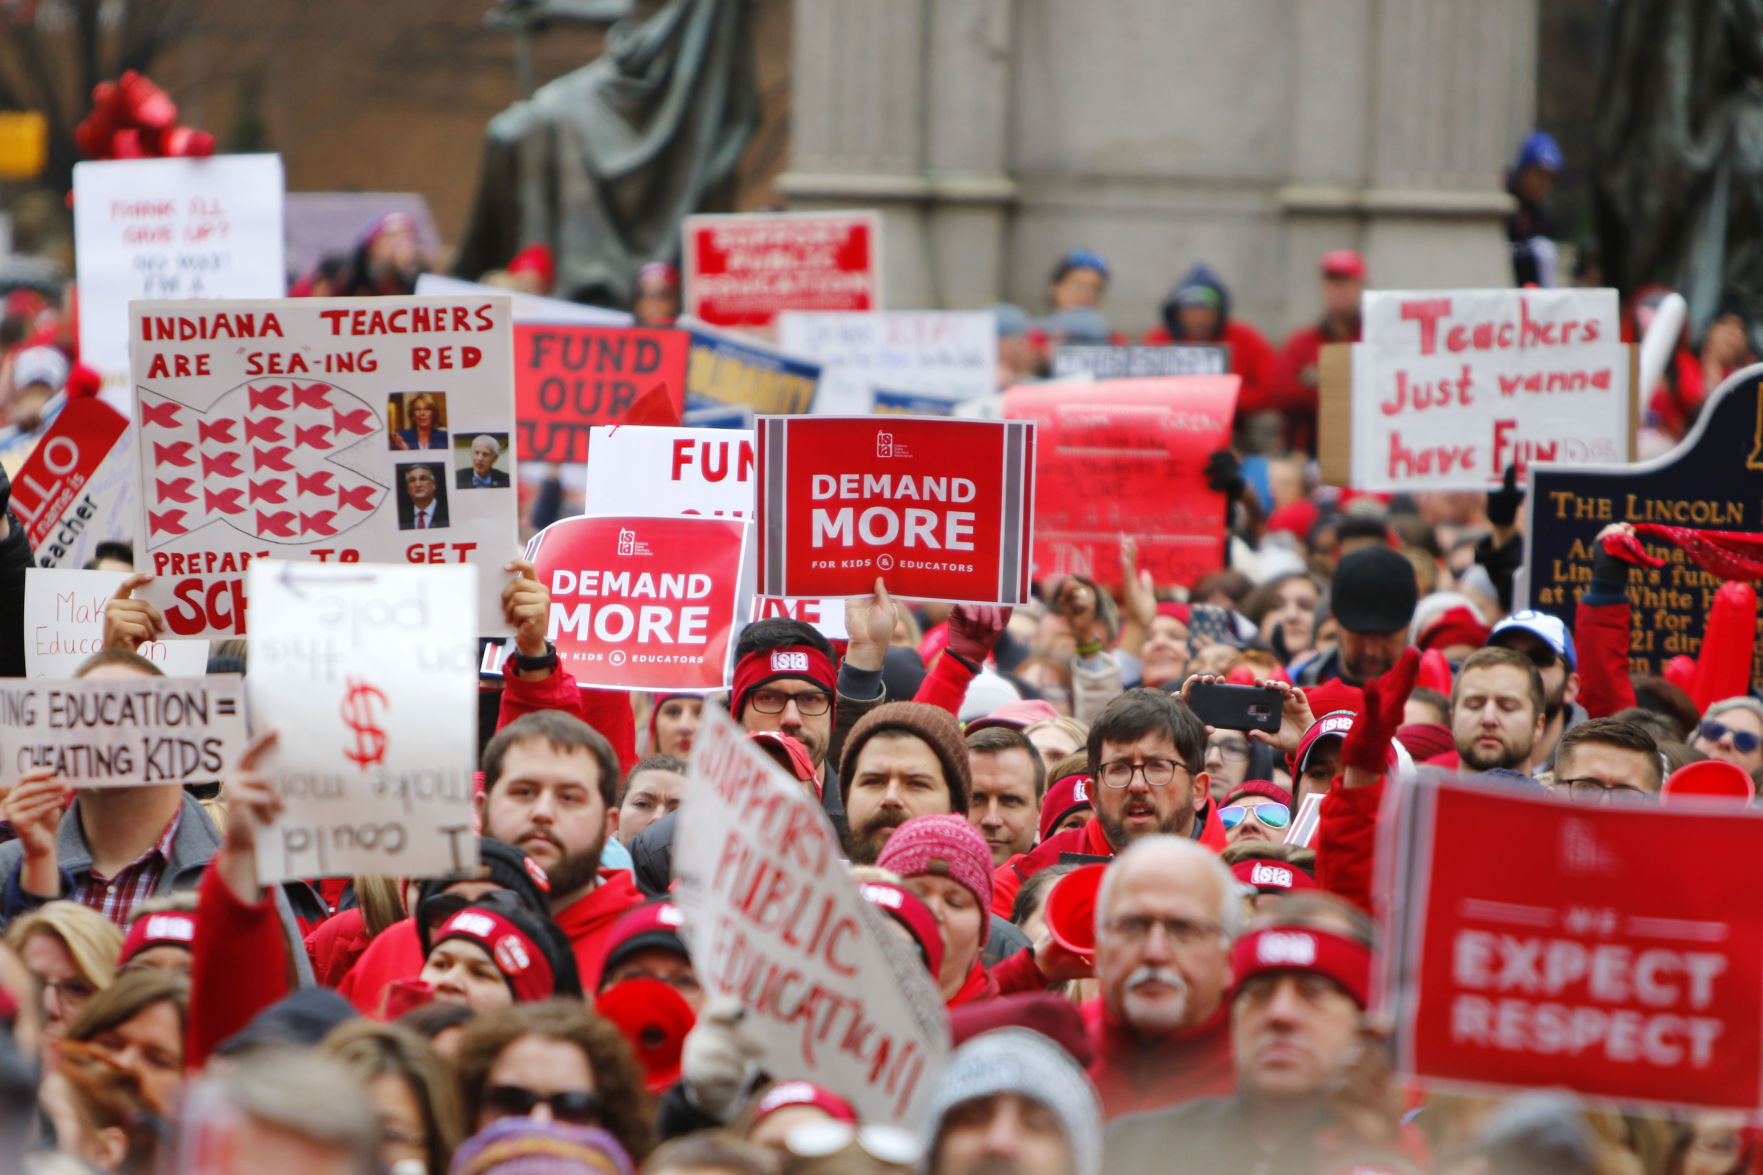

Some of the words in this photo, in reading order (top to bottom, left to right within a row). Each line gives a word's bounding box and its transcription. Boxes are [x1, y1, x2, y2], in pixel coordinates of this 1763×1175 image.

[141, 312, 285, 342] INDIANA
[319, 303, 495, 337] TEACHERS
[1400, 296, 1601, 356] Teachers
[147, 352, 212, 379] ARE
[411, 346, 483, 371] RED
[530, 333, 662, 374] FUND
[539, 377, 637, 417] OUR
[1499, 367, 1613, 398] wanna
[1388, 432, 1477, 479] have
[812, 473, 977, 503] DEMAND
[40, 493, 98, 568] eacher
[812, 506, 976, 551] MORE
[152, 550, 270, 577] PREPAR
[406, 542, 477, 565] GET
[812, 560, 836, 569] FOR
[841, 558, 872, 568] KIDS
[899, 559, 974, 573] EDUCATORS
[551, 569, 712, 600] DEMAND
[56, 591, 107, 624] Mak
[547, 602, 710, 645] MORE
[1654, 607, 1692, 631] for
[573, 652, 604, 661] KIDS
[631, 655, 704, 664] EDUCATORS
[48, 690, 210, 730] EDUCATION
[16, 744, 134, 780] CHEATING
[141, 737, 224, 783] KIDS
[282, 823, 408, 874] could
[437, 825, 471, 875] I
[712, 827, 863, 977] PUBLIC
[1453, 927, 1730, 1010] EXPECT
[1452, 992, 1726, 1070] RESPECT
